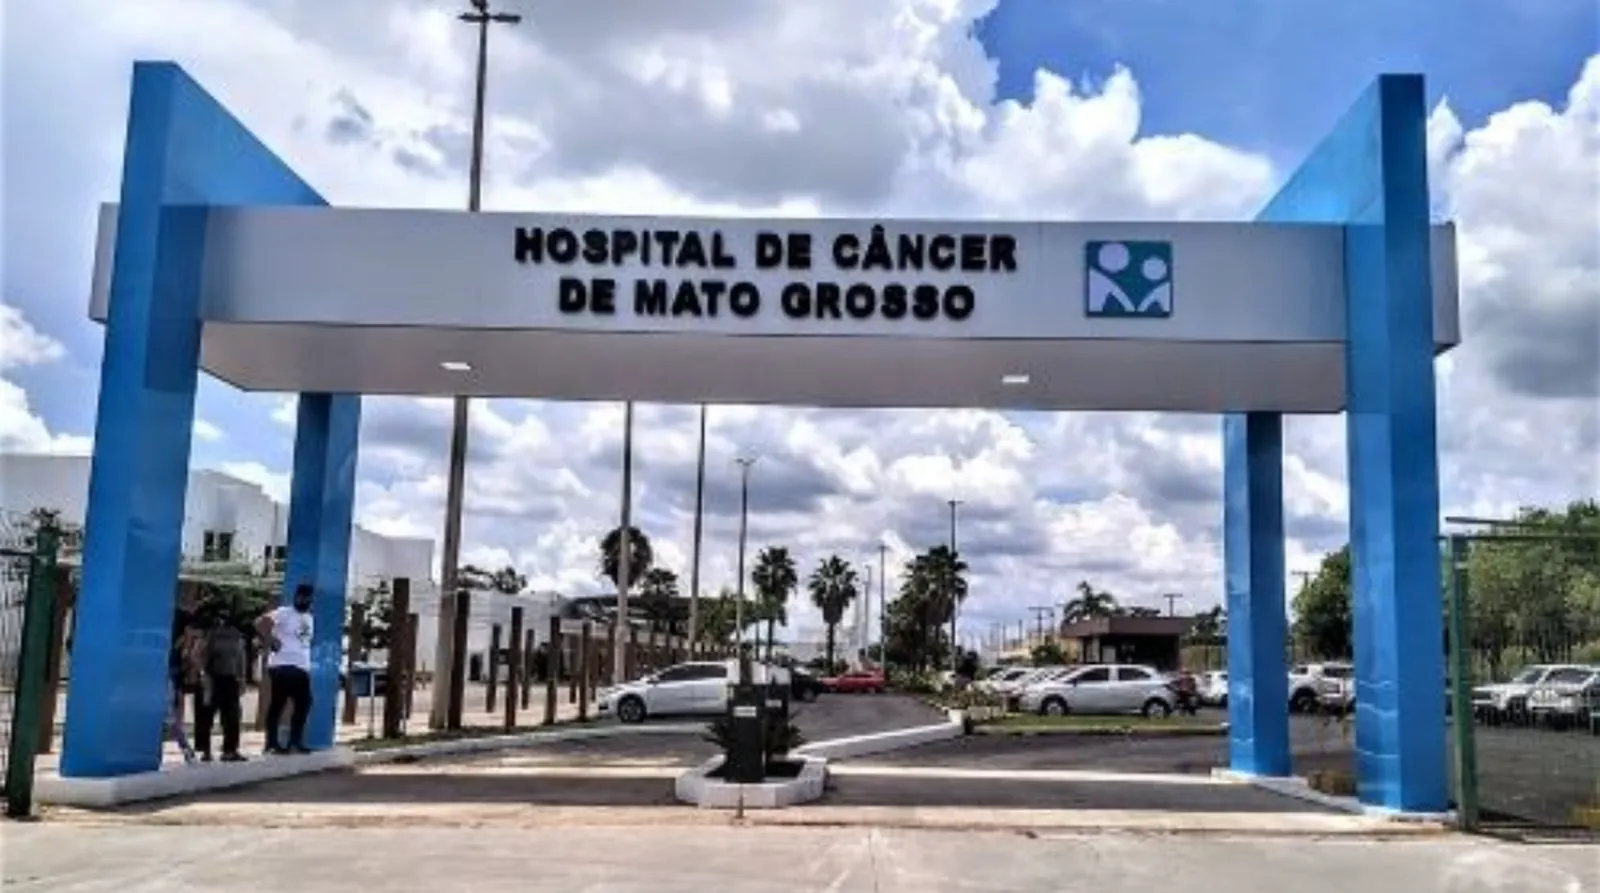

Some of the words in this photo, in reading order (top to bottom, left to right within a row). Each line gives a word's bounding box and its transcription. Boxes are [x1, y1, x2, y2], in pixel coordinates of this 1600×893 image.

[514, 226, 736, 269] HOSPITAL
[756, 232, 812, 270] DE
[832, 224, 1018, 273] CÂNCER
[559, 278, 615, 316] DE
[634, 279, 761, 318] MATO
[781, 282, 975, 321] GROSSO
